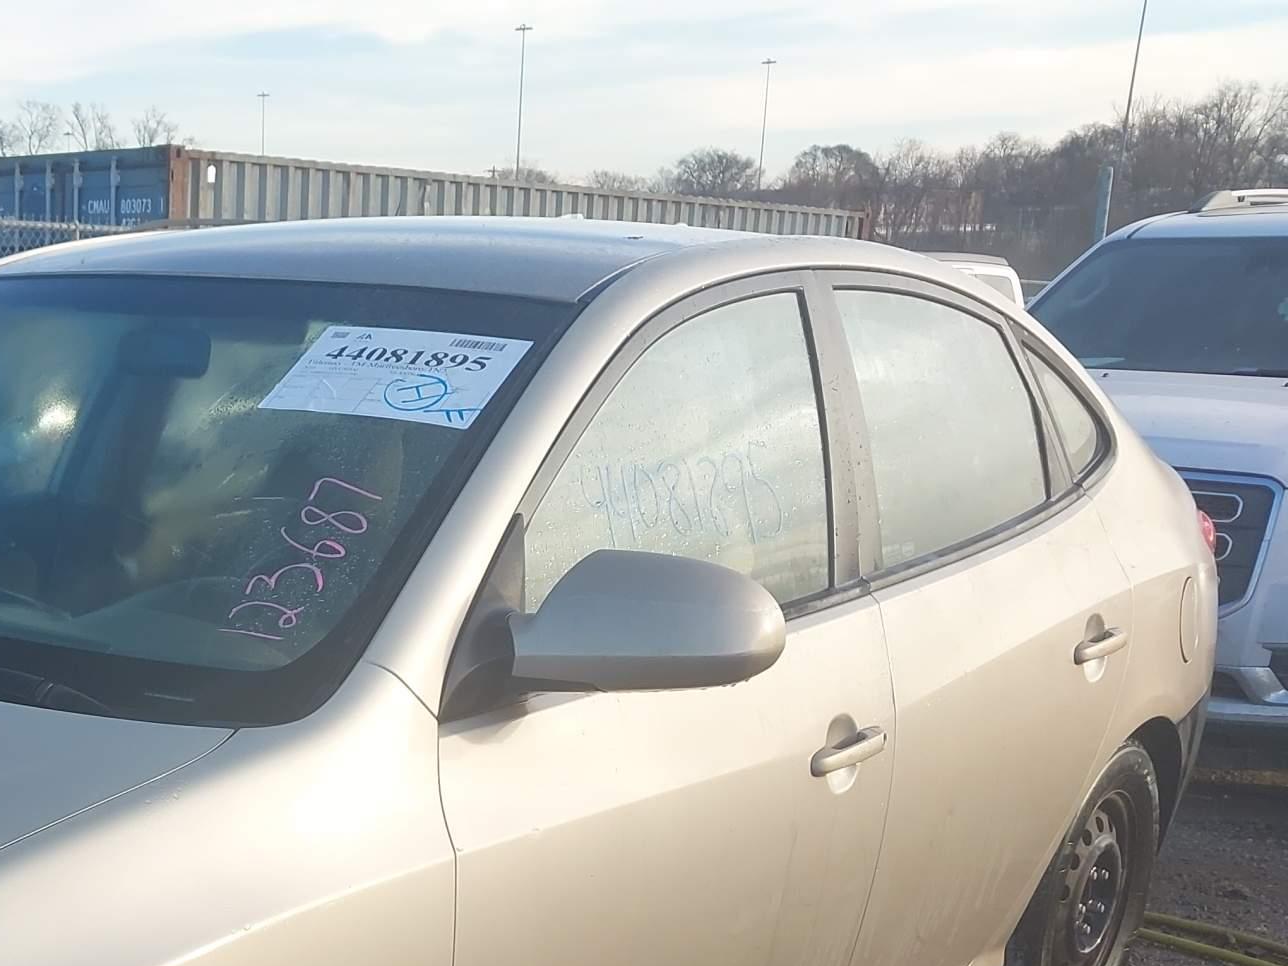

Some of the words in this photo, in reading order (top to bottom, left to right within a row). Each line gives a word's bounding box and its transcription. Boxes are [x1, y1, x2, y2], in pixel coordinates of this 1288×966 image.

[120, 198, 152, 214] 803073
[325, 345, 493, 373] 44081895
[215, 477, 383, 640] 123687
